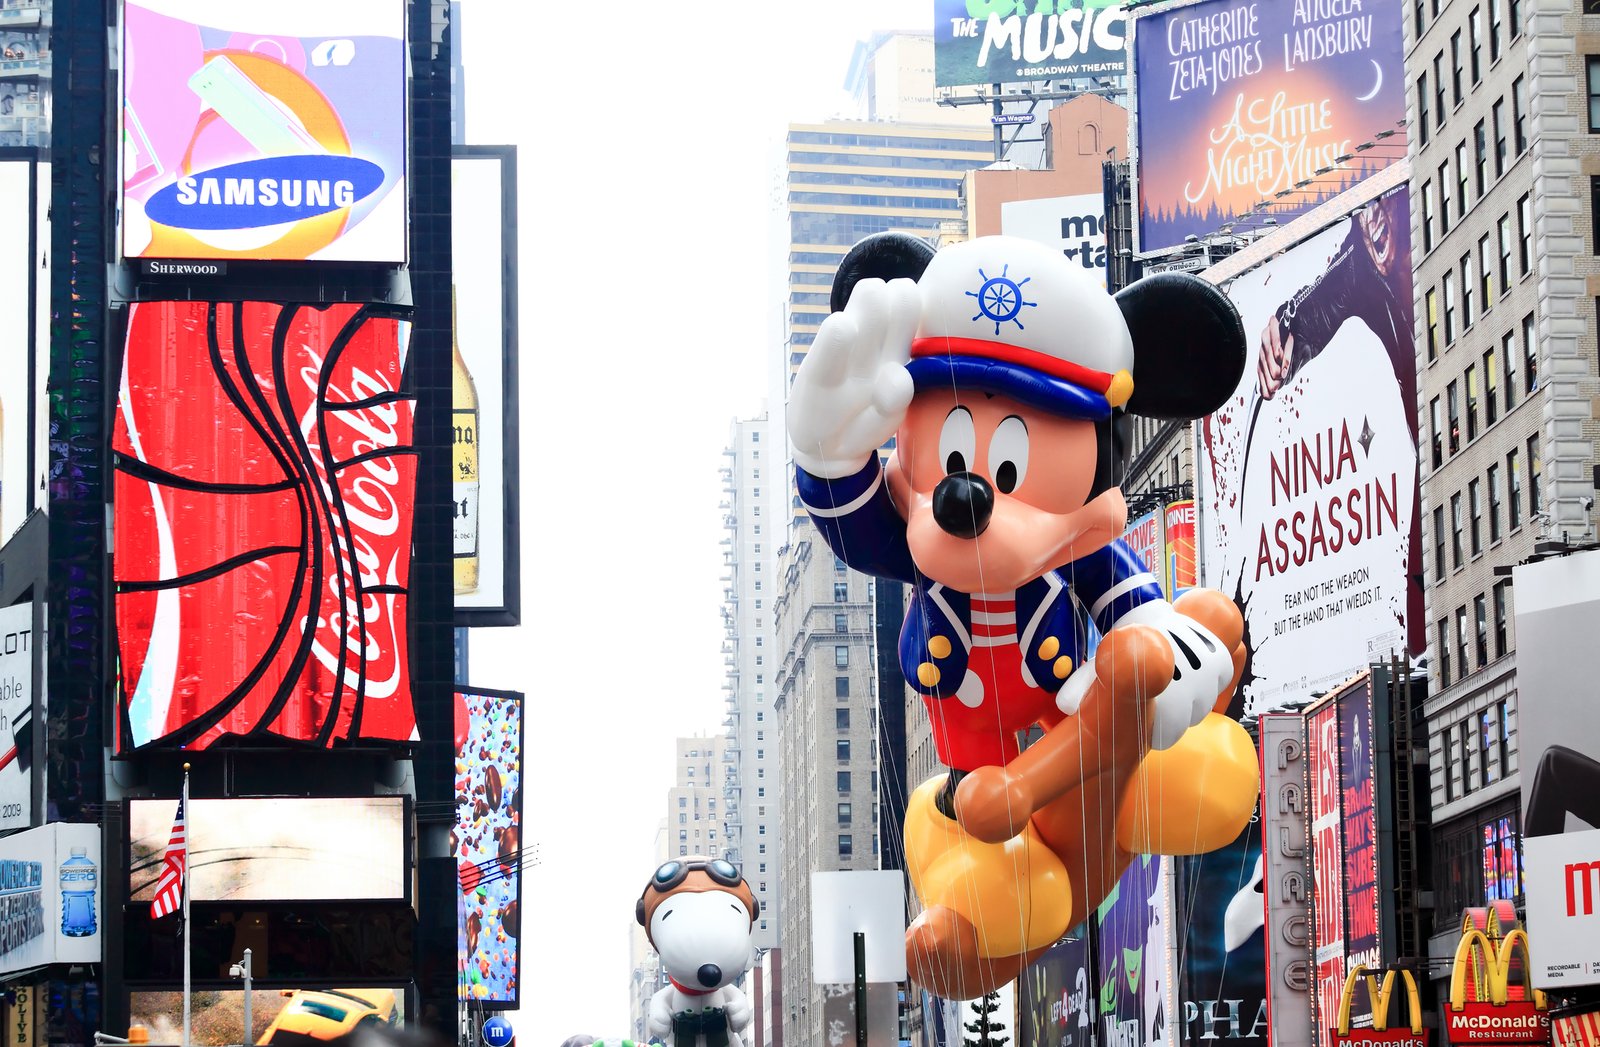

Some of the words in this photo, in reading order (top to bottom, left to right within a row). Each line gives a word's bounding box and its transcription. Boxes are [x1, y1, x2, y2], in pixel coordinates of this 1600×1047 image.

[951, 18, 979, 37] THE
[1167, 3, 1260, 56] CATHERINE
[1284, 14, 1373, 73] LANSBURY
[1024, 65, 1078, 76] BROADWAY
[1081, 62, 1124, 73] THEATRE
[1168, 40, 1263, 100] ZETA-JONES
[994, 115, 1006, 123] Van
[1007, 114, 1034, 124] Wagner
[1210, 92, 1245, 144] A
[1248, 91, 1332, 147] LITTLE
[1184, 135, 1275, 203] NIGHT
[177, 177, 355, 208] SAMSUNG
[150, 261, 218, 275] SHERWOOD
[1270, 417, 1358, 507] NINJA
[1255, 472, 1399, 582] ASSASSIN
[1284, 590, 1302, 610] FEAR
[1303, 584, 1320, 603] NOT
[1321, 579, 1334, 598] THE
[1336, 566, 1370, 594] WEAPON
[1274, 620, 1287, 637] BUT
[1288, 613, 1301, 632] THE
[1302, 606, 1325, 627] HAND
[1326, 599, 1344, 619] THAT
[1344, 591, 1373, 615] WIELDS
[1374, 585, 1382, 602] IT.
[0, 630, 31, 656] OT
[3, 803, 22, 818] 2009
[61, 872, 96, 882] ZERO
[1278, 738, 1307, 991] PALACE
[1346, 843, 1375, 892] SURE
[1347, 888, 1377, 941] THING
[1547, 963, 1580, 971] RECORDABLE
[16, 993, 28, 1043] OLIVE
[1051, 1000, 1062, 1024] LEFT
[1452, 1014, 1550, 1029] McDonald's
[490, 1024, 504, 1038] m
[1339, 1039, 1424, 1047] McDonald's
[1469, 1030, 1534, 1039] Restaurant
